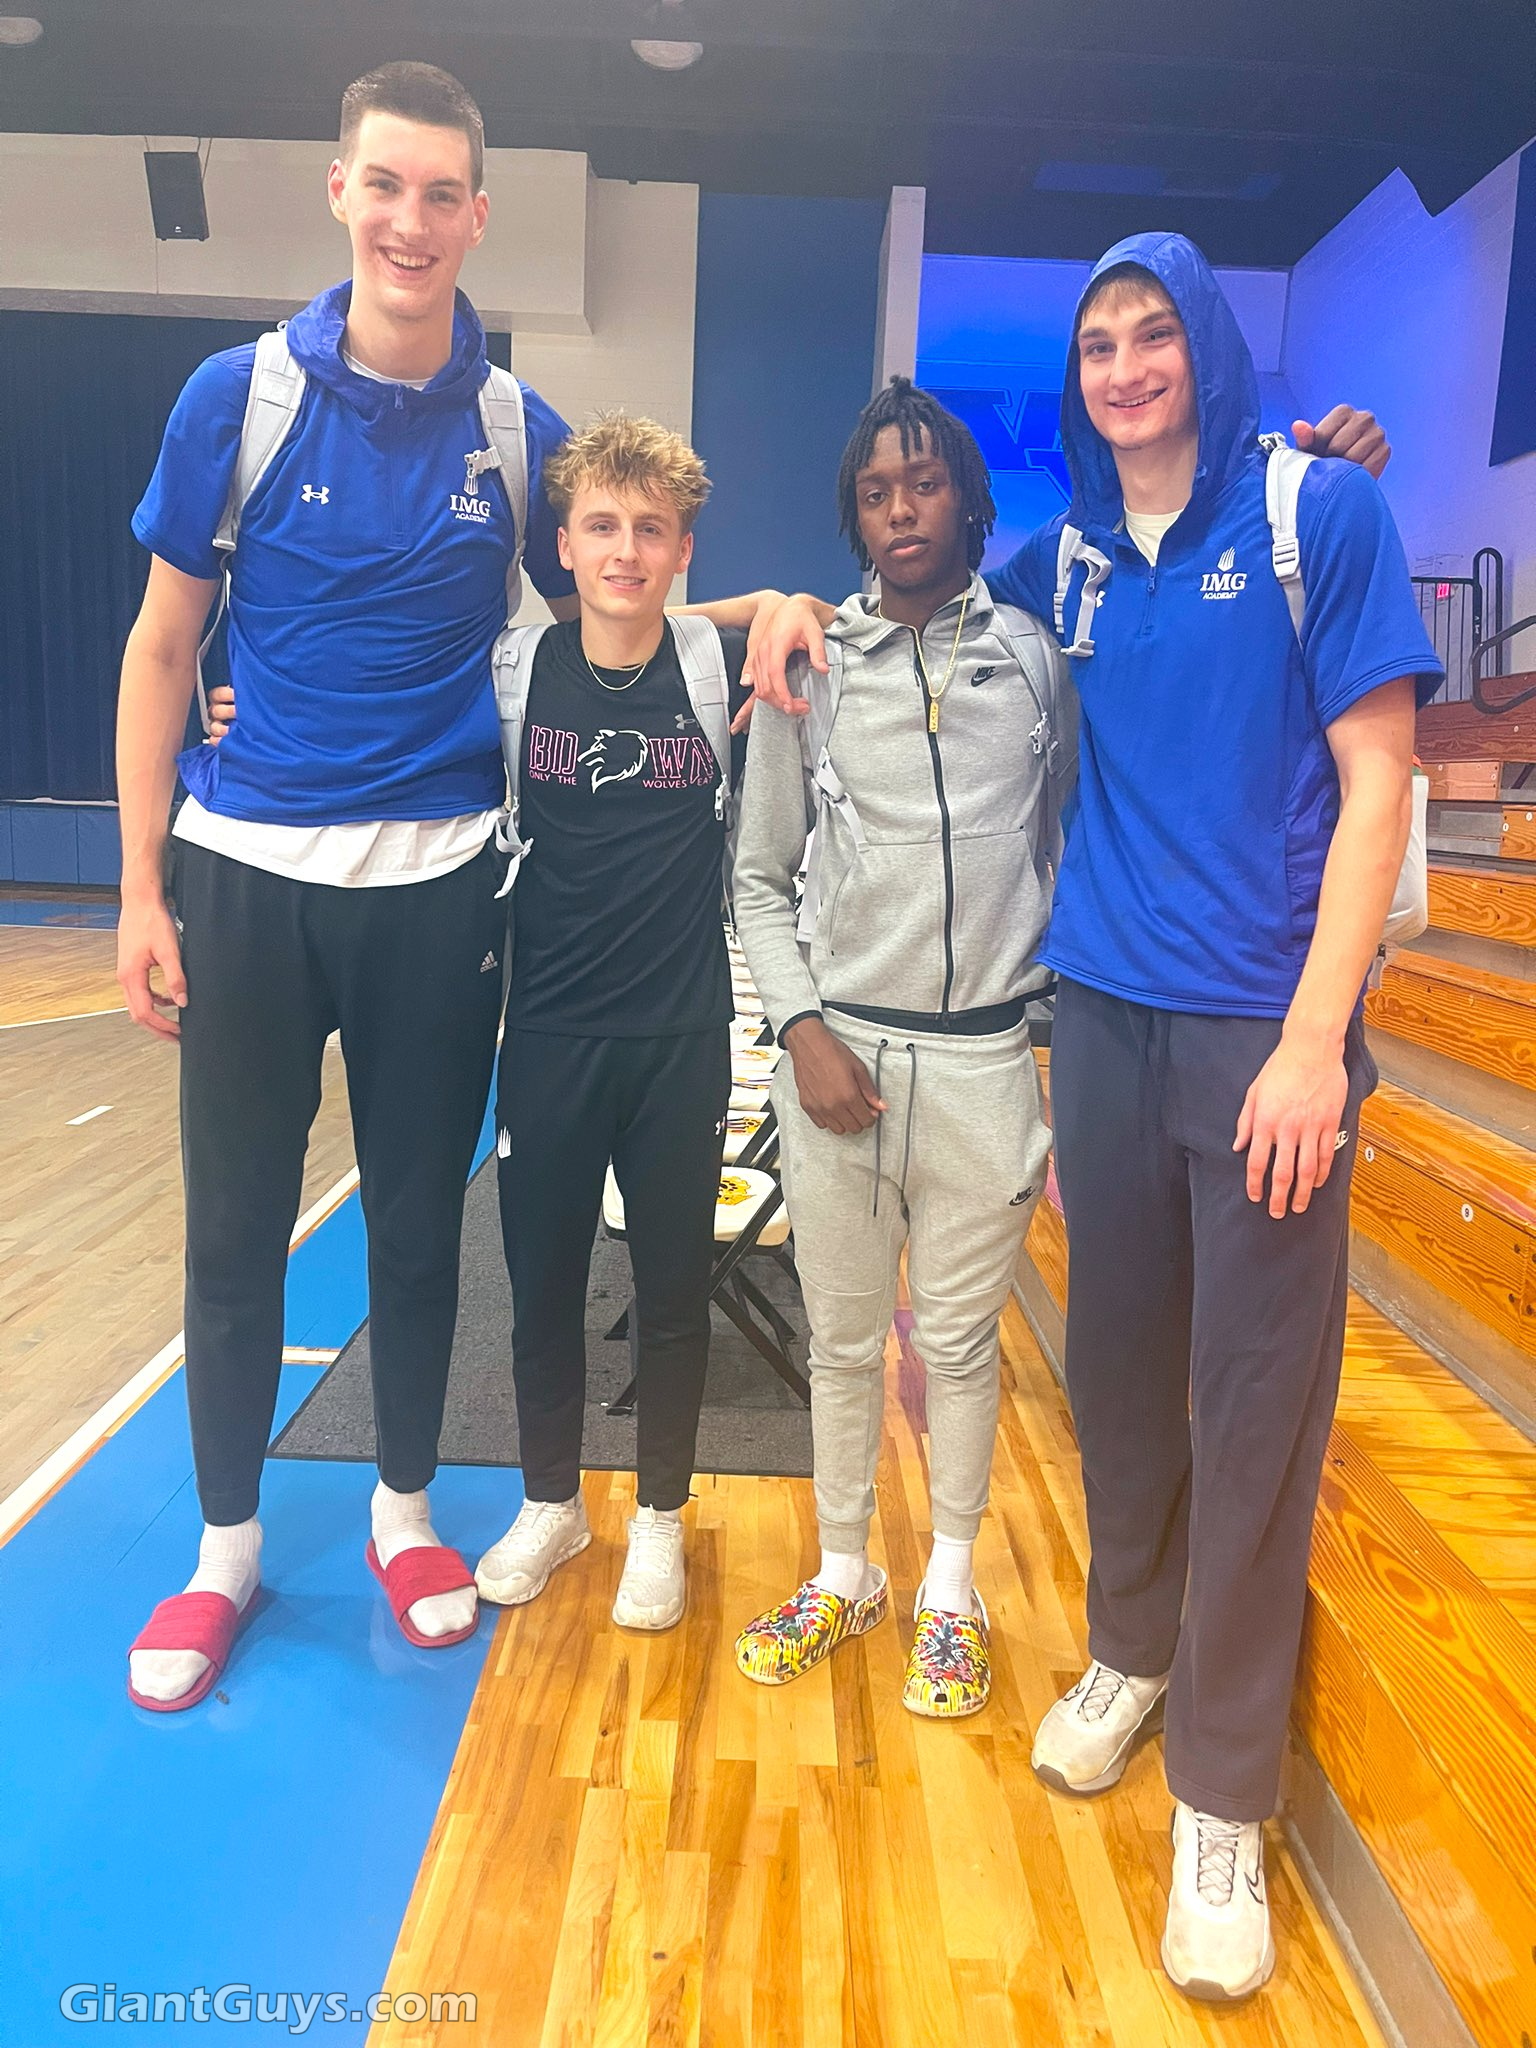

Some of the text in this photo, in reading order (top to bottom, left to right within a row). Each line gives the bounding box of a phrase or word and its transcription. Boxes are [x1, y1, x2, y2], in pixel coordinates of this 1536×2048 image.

[449, 494, 491, 517] IMG
[455, 512, 487, 524] ACADEMY
[1200, 572, 1248, 592] IMG
[1202, 591, 1238, 600] ACADEMY
[528, 769, 551, 782] ONLY
[557, 775, 577, 786] THE
[642, 779, 688, 789] WOLVES
